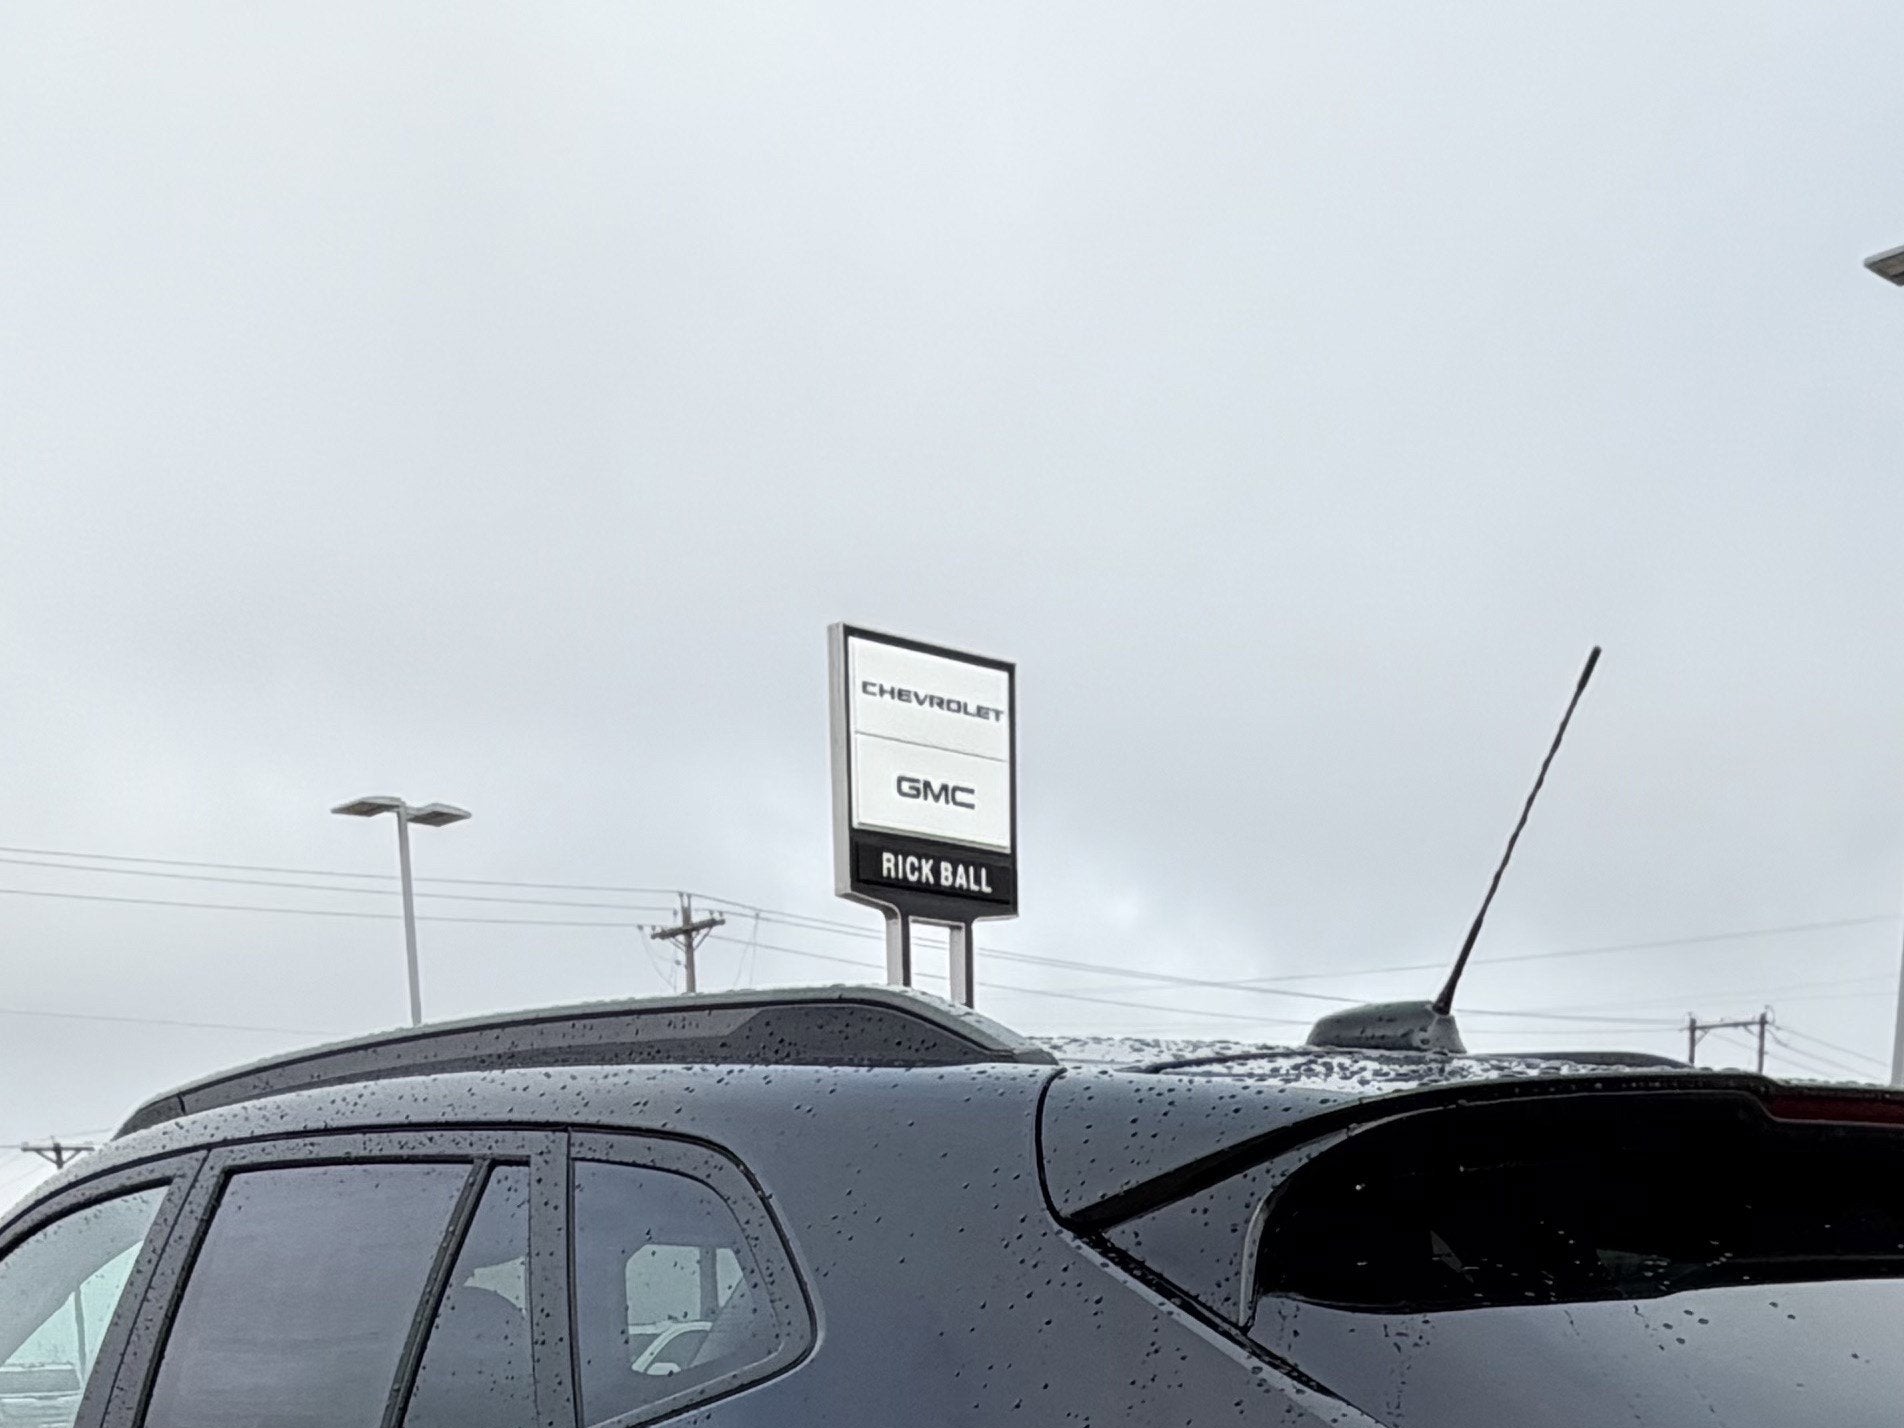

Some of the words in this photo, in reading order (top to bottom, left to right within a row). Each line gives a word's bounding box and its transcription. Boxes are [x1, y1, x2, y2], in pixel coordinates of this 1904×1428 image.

[862, 680, 1004, 723] CHEVROLET
[896, 775, 976, 810] GMC
[882, 851, 935, 885] RICK
[940, 861, 993, 894] BALL
